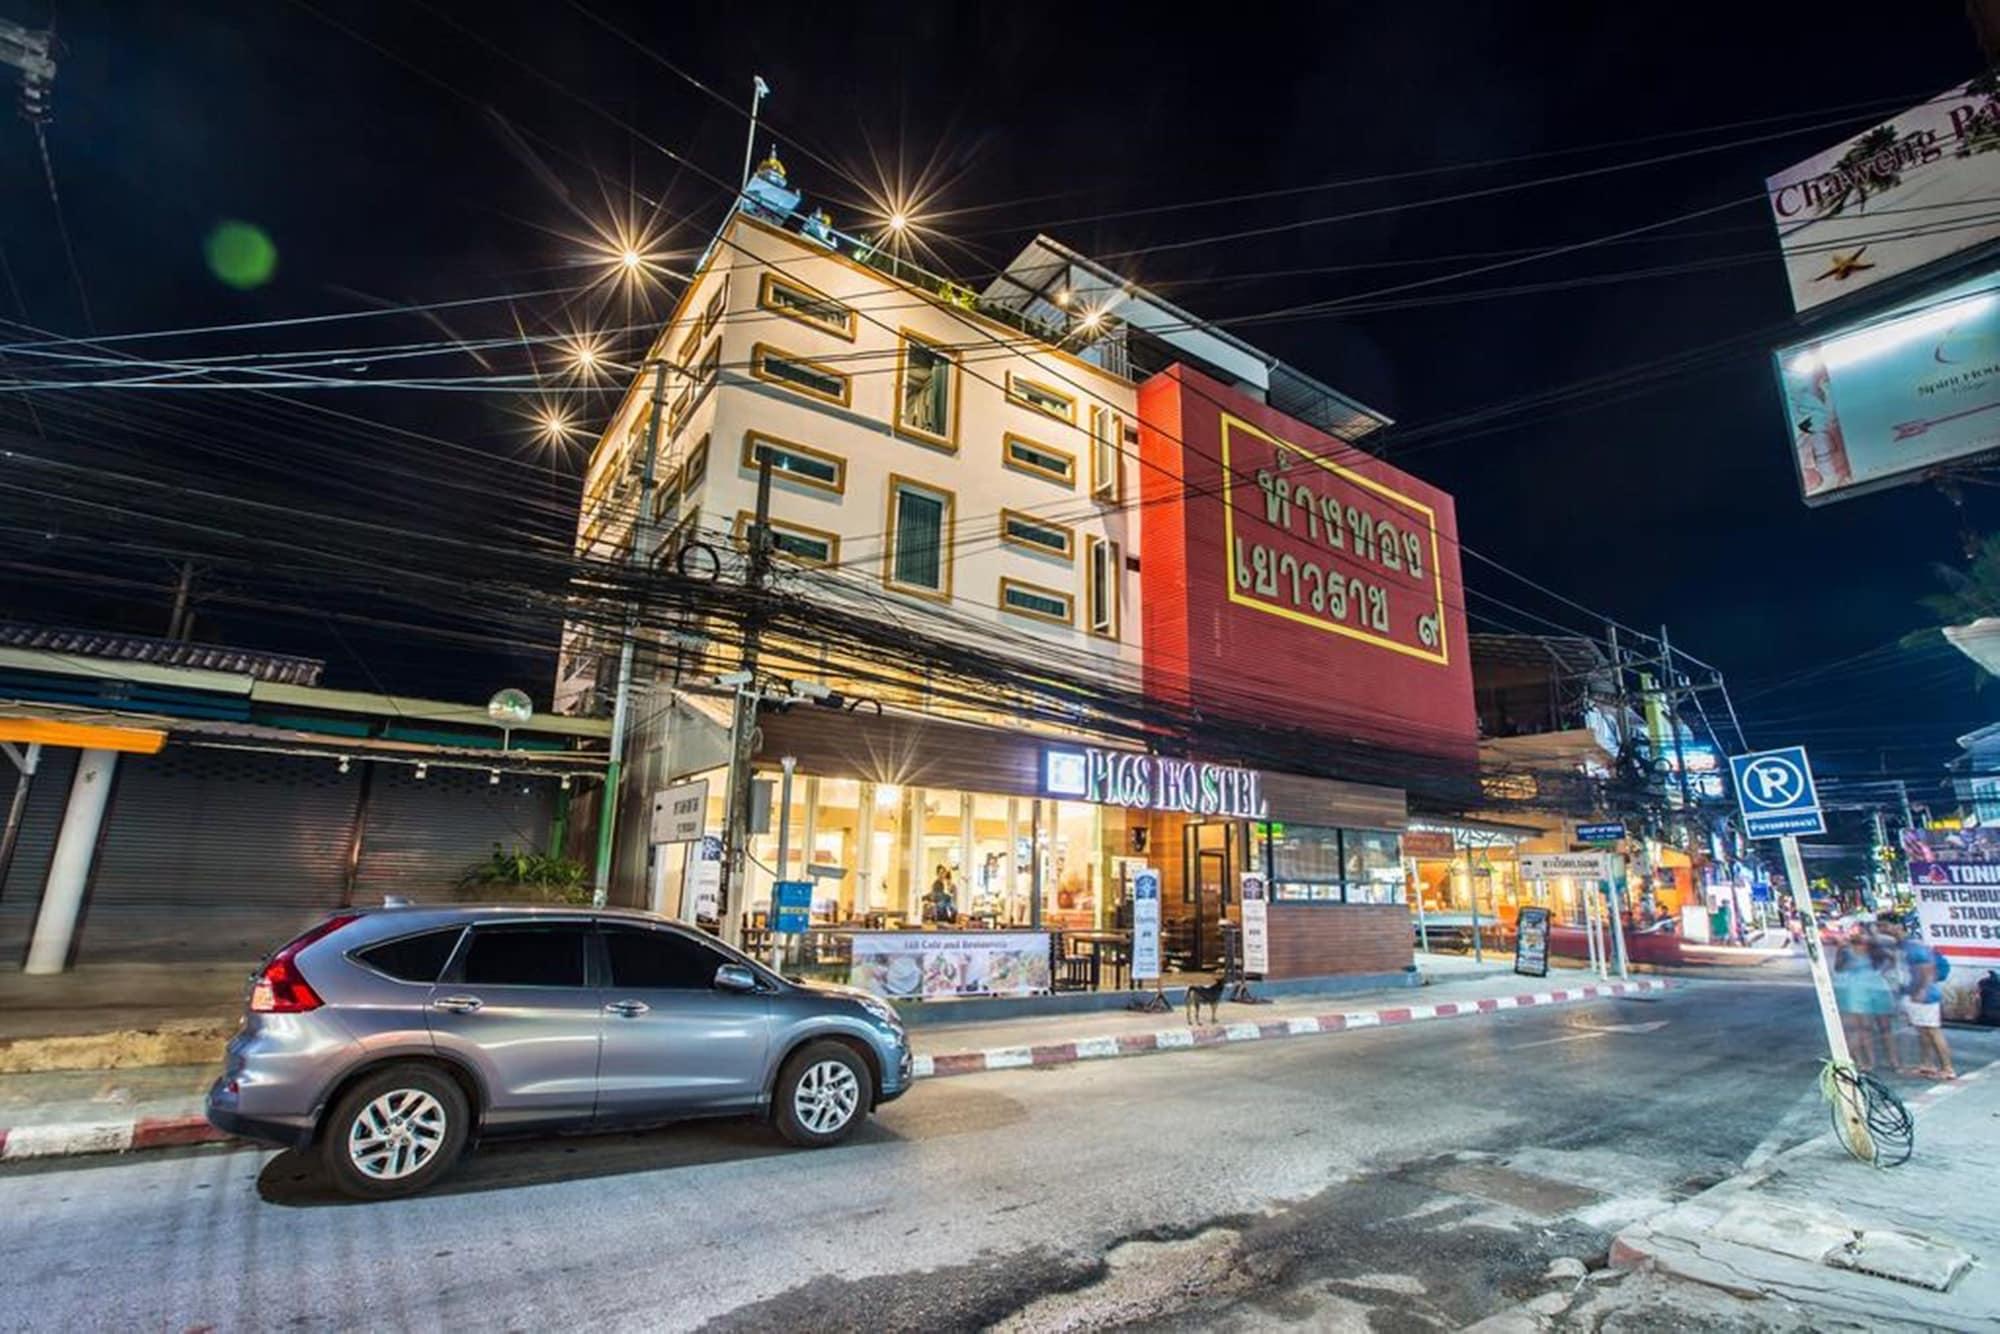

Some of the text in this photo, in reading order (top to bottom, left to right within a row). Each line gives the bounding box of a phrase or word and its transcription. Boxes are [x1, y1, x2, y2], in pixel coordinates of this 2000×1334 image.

[1775, 128, 1943, 217] Chaweng
[1152, 759, 1268, 820] HOSTEL
[1948, 864, 2000, 883] TONI
[1930, 924, 1977, 938] START
